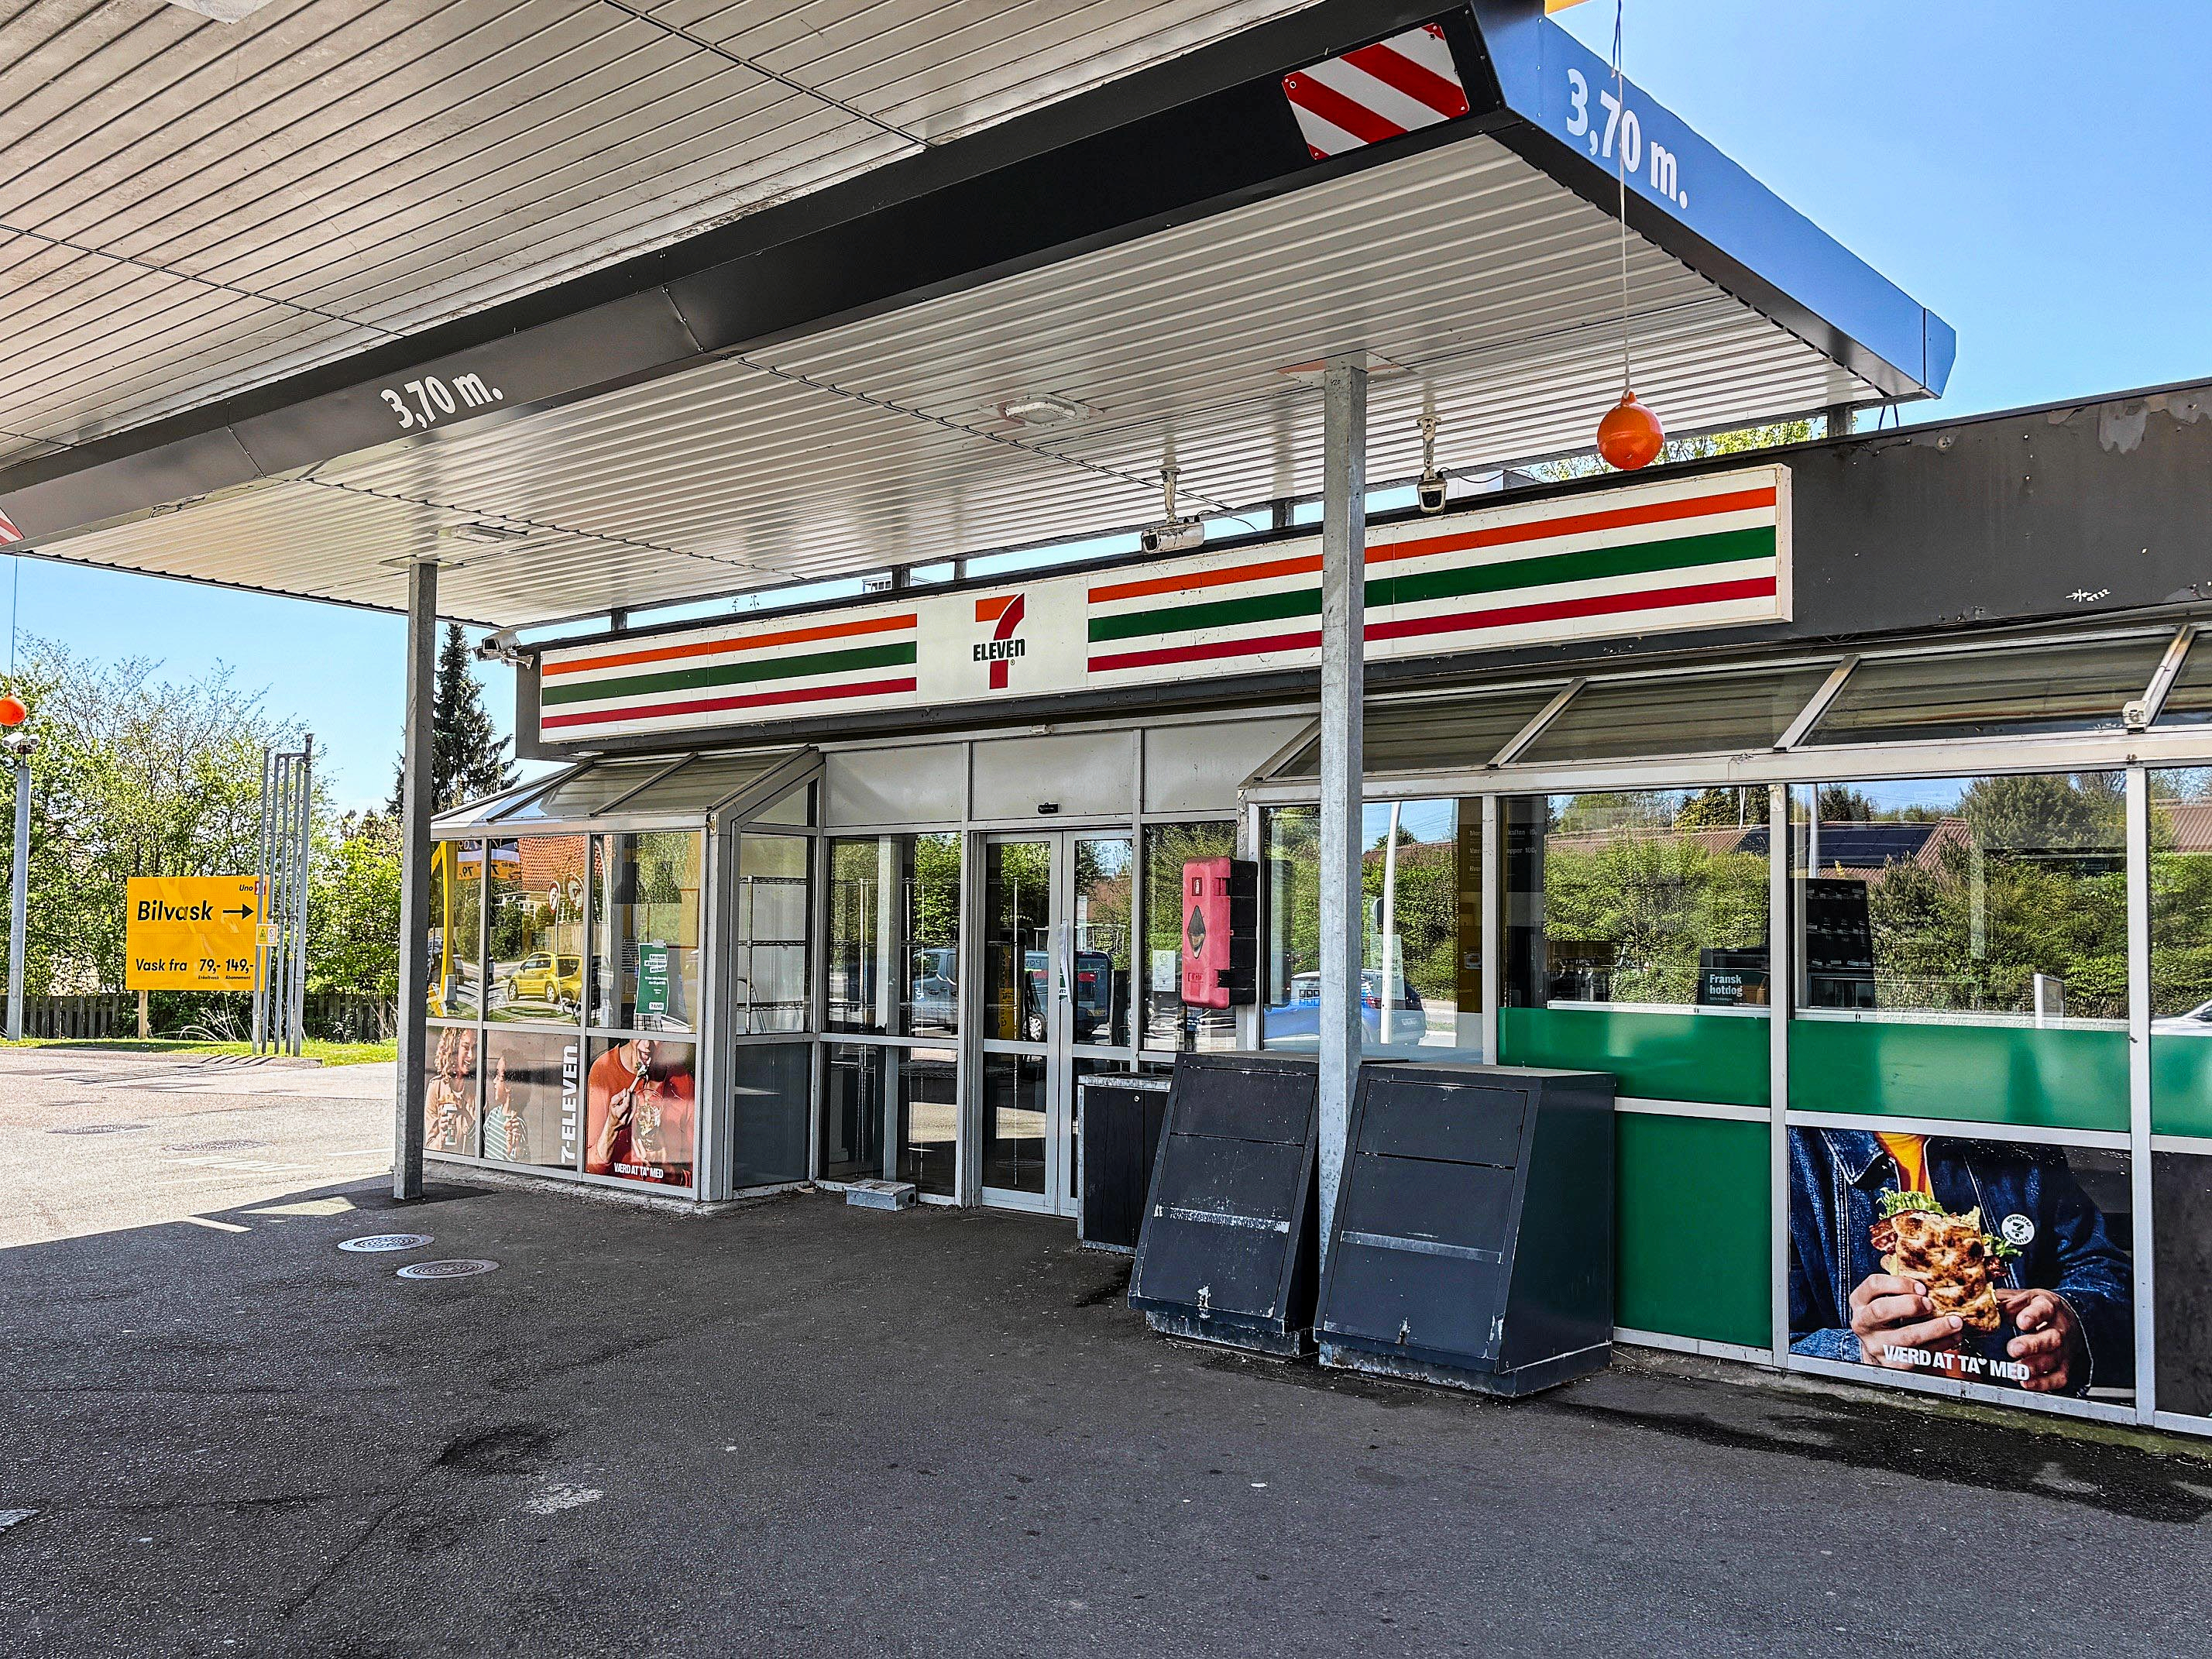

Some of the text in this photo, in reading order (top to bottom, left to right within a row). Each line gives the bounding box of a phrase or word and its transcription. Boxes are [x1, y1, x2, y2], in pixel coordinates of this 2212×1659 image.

[1566, 68, 1688, 209] 3,70 m.
[380, 373, 503, 429] 3,70 m.
[975, 592, 1025, 690] 7
[137, 899, 214, 921] Bilvask
[136, 958, 254, 974] Vask fra 79,- 149,-
[1709, 974, 1742, 984] Fransk
[1709, 984, 1743, 998] hotdog
[630, 1165, 639, 1175] AT
[649, 1168, 664, 1179] MED
[1883, 1345, 1932, 1366] VÆRD
[1932, 1352, 1955, 1369] AT
[1990, 1360, 2030, 1381] MED
